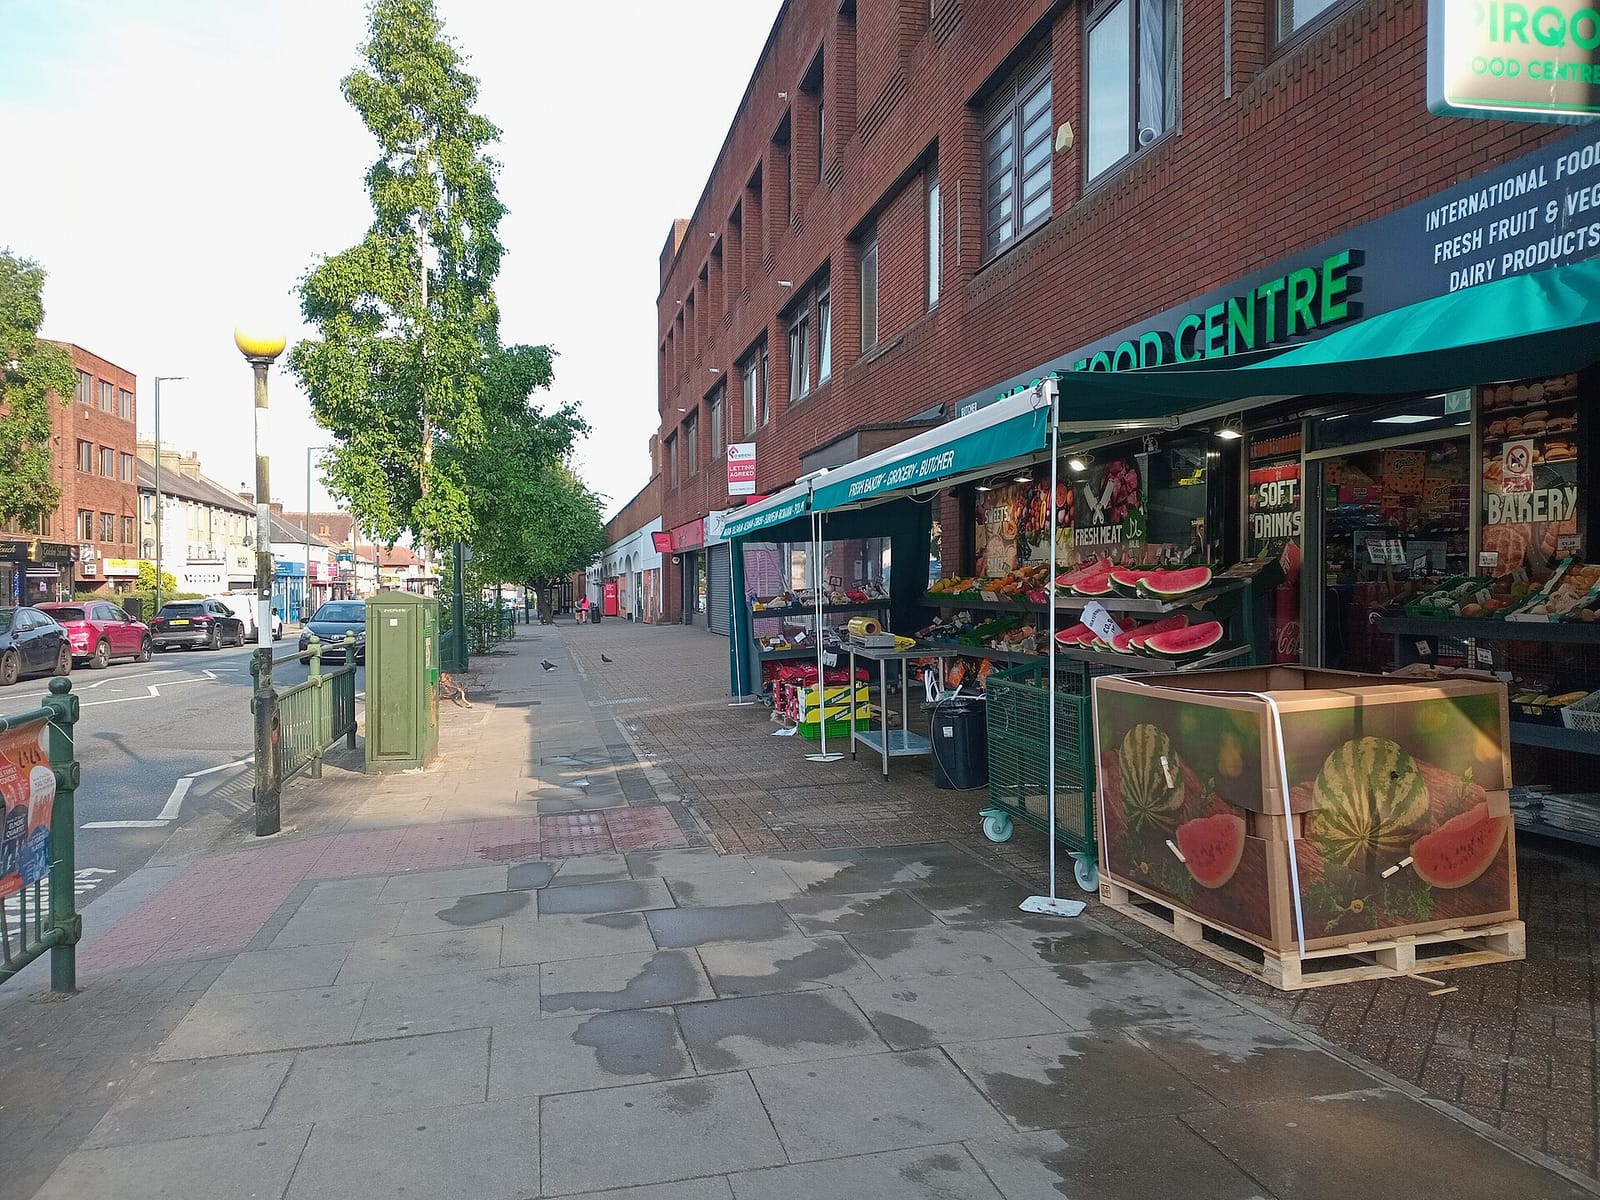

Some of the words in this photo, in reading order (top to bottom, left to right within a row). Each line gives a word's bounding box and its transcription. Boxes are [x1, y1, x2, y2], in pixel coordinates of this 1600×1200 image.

[1471, 56, 1521, 78] OOD
[1528, 60, 1600, 84] CENTRE
[1426, 165, 1548, 233] INTERNATIONAL
[1434, 228, 1483, 265] FRESH
[1489, 207, 1539, 245] FRUIT
[1545, 200, 1559, 224] &
[1567, 183, 1600, 216] VEG
[1450, 258, 1496, 292] DAIRY
[1502, 222, 1600, 276] PRODUCTS
[1174, 249, 1351, 363] CENTRE
[887, 462, 918, 486] GROCERY
[919, 450, 955, 477] BUTCHER
[1259, 479, 1297, 508] SOFT
[1488, 486, 1577, 525] BAKERY
[984, 506, 1009, 524] SWEETS
[1254, 511, 1302, 539] DRINKS
[1075, 526, 1099, 546] FRESH
[1100, 525, 1123, 545] MEAT
